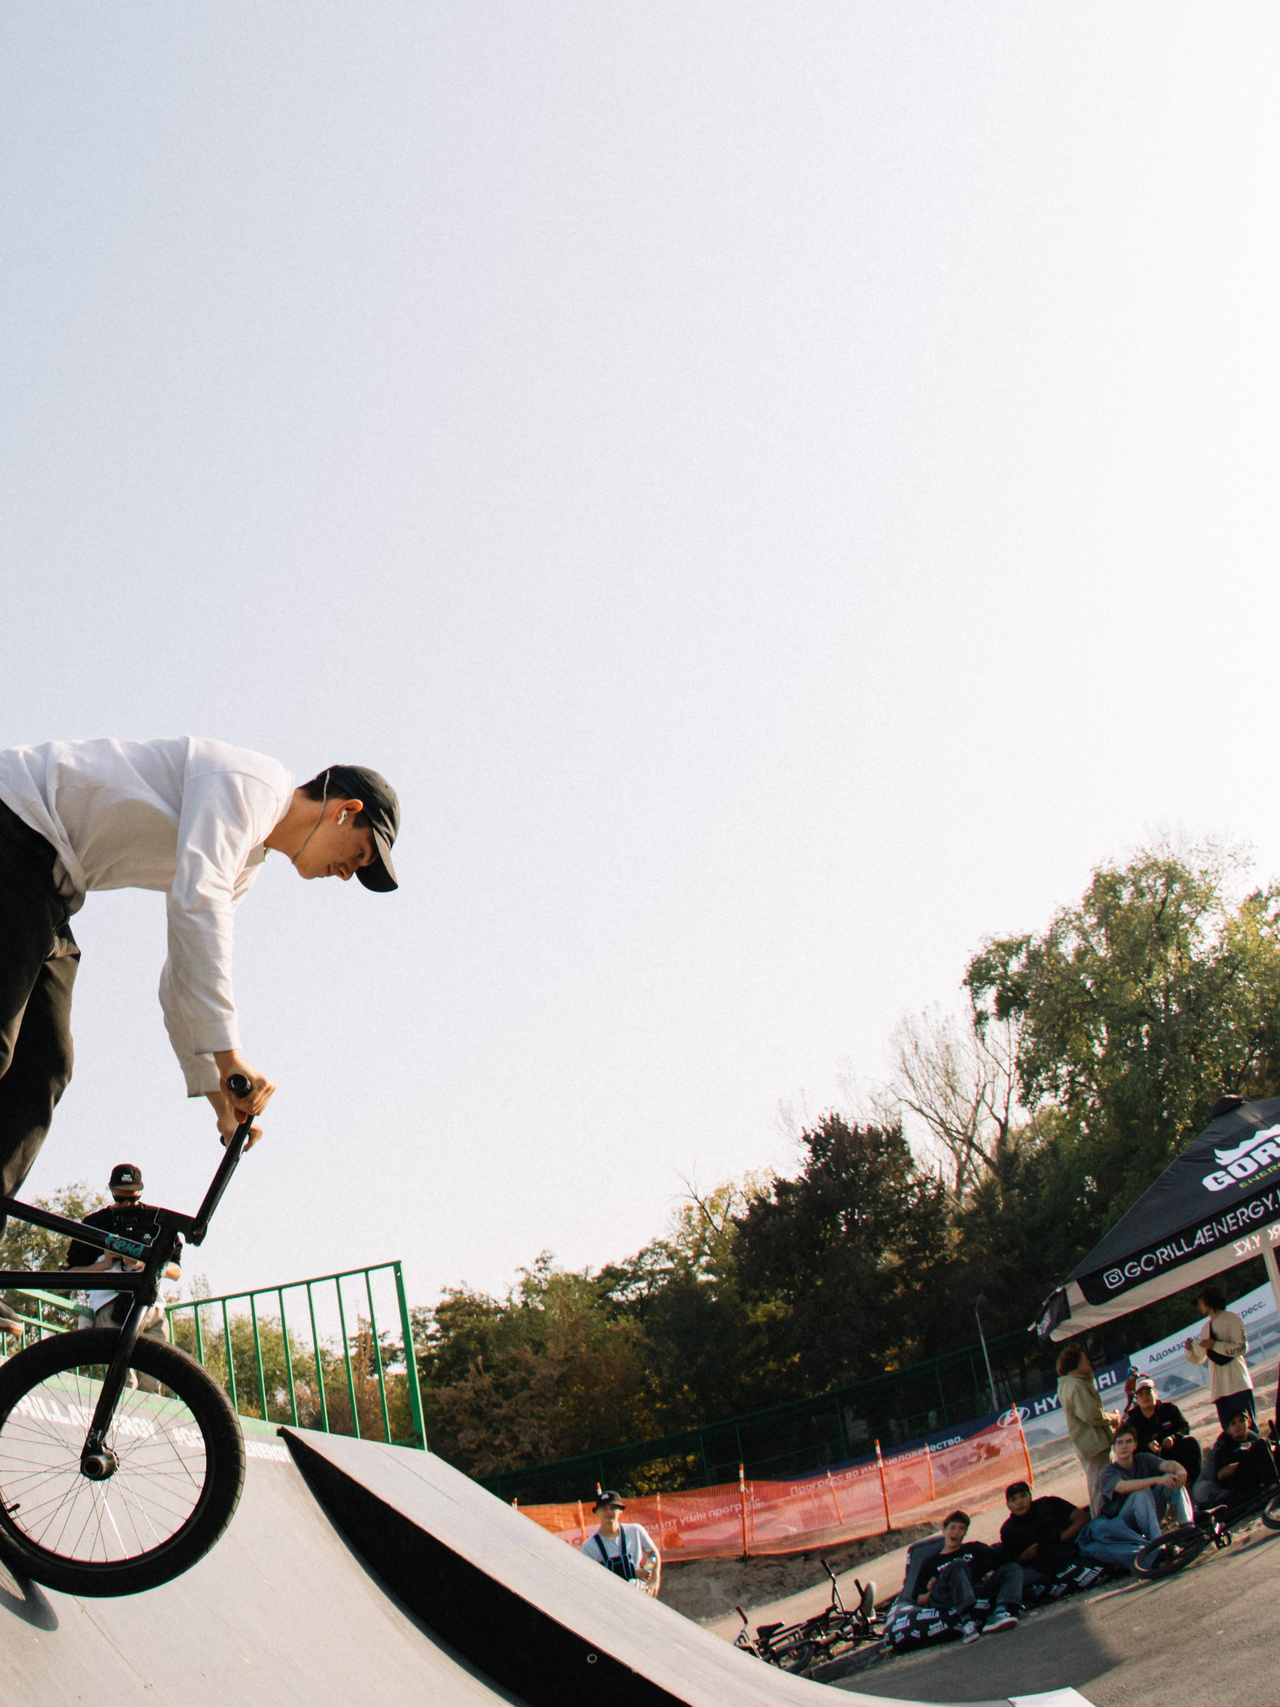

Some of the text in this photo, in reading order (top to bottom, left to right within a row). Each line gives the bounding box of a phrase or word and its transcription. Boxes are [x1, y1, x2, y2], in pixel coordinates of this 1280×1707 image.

[1202, 1136, 1280, 1192] GOR
[1239, 1161, 1280, 1189] ENER
[1124, 1189, 1280, 1278] GORILLAENERGY.
[1033, 1370, 1117, 1416] HYAI
